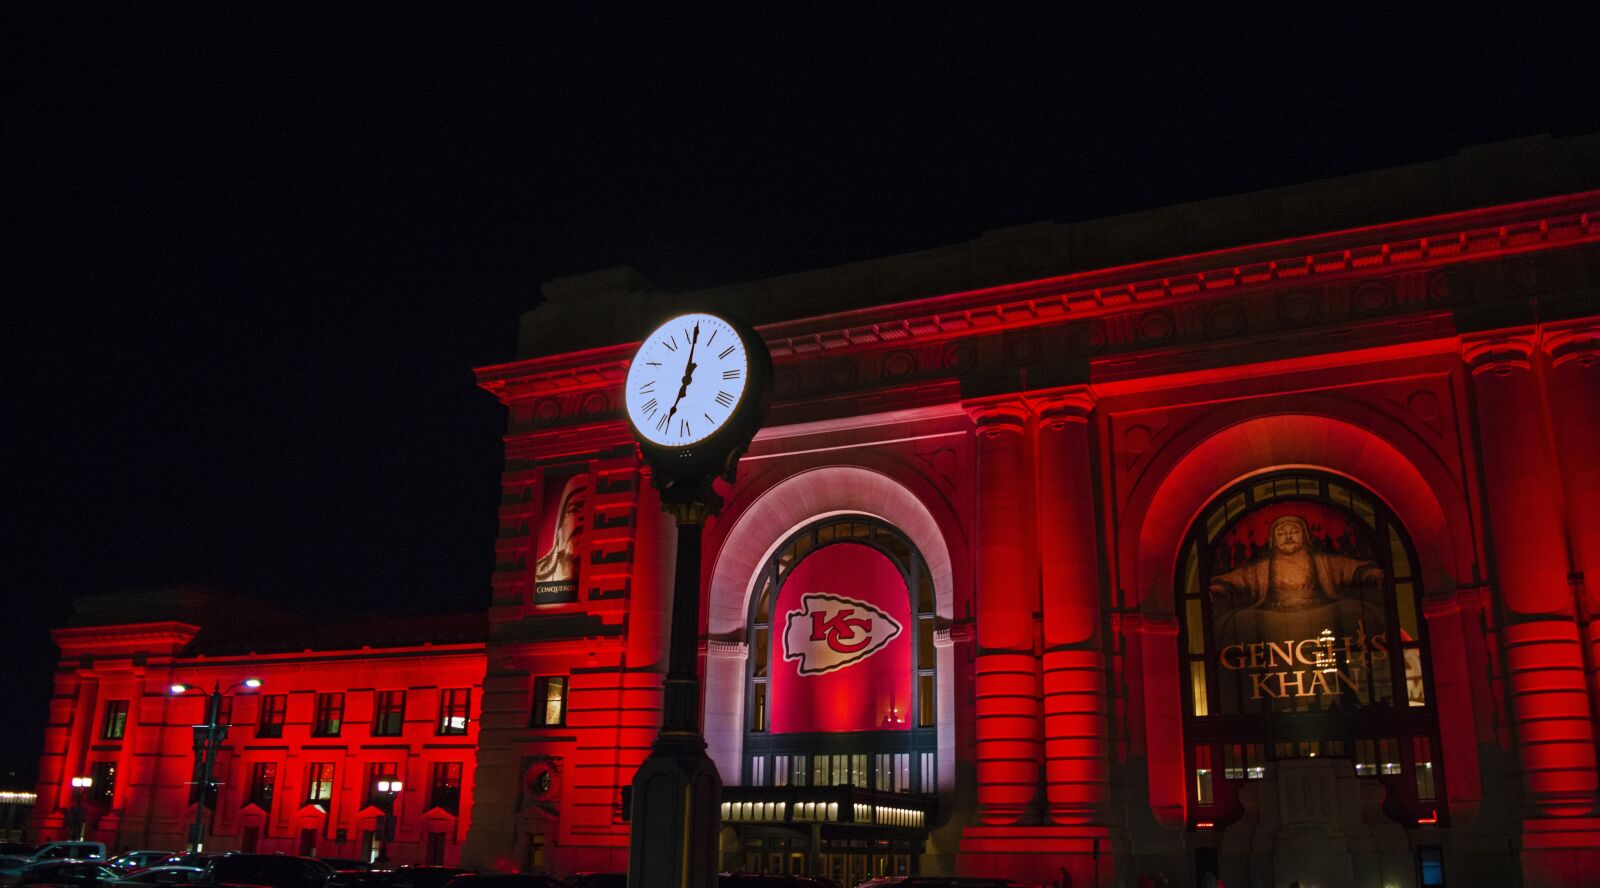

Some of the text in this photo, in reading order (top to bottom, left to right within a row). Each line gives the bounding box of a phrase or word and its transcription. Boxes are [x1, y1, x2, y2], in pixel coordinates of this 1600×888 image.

[722, 369, 741, 380] III
[810, 610, 872, 653] KC
[1220, 621, 1388, 670] GENGHIS
[1248, 668, 1362, 700] KHAN
